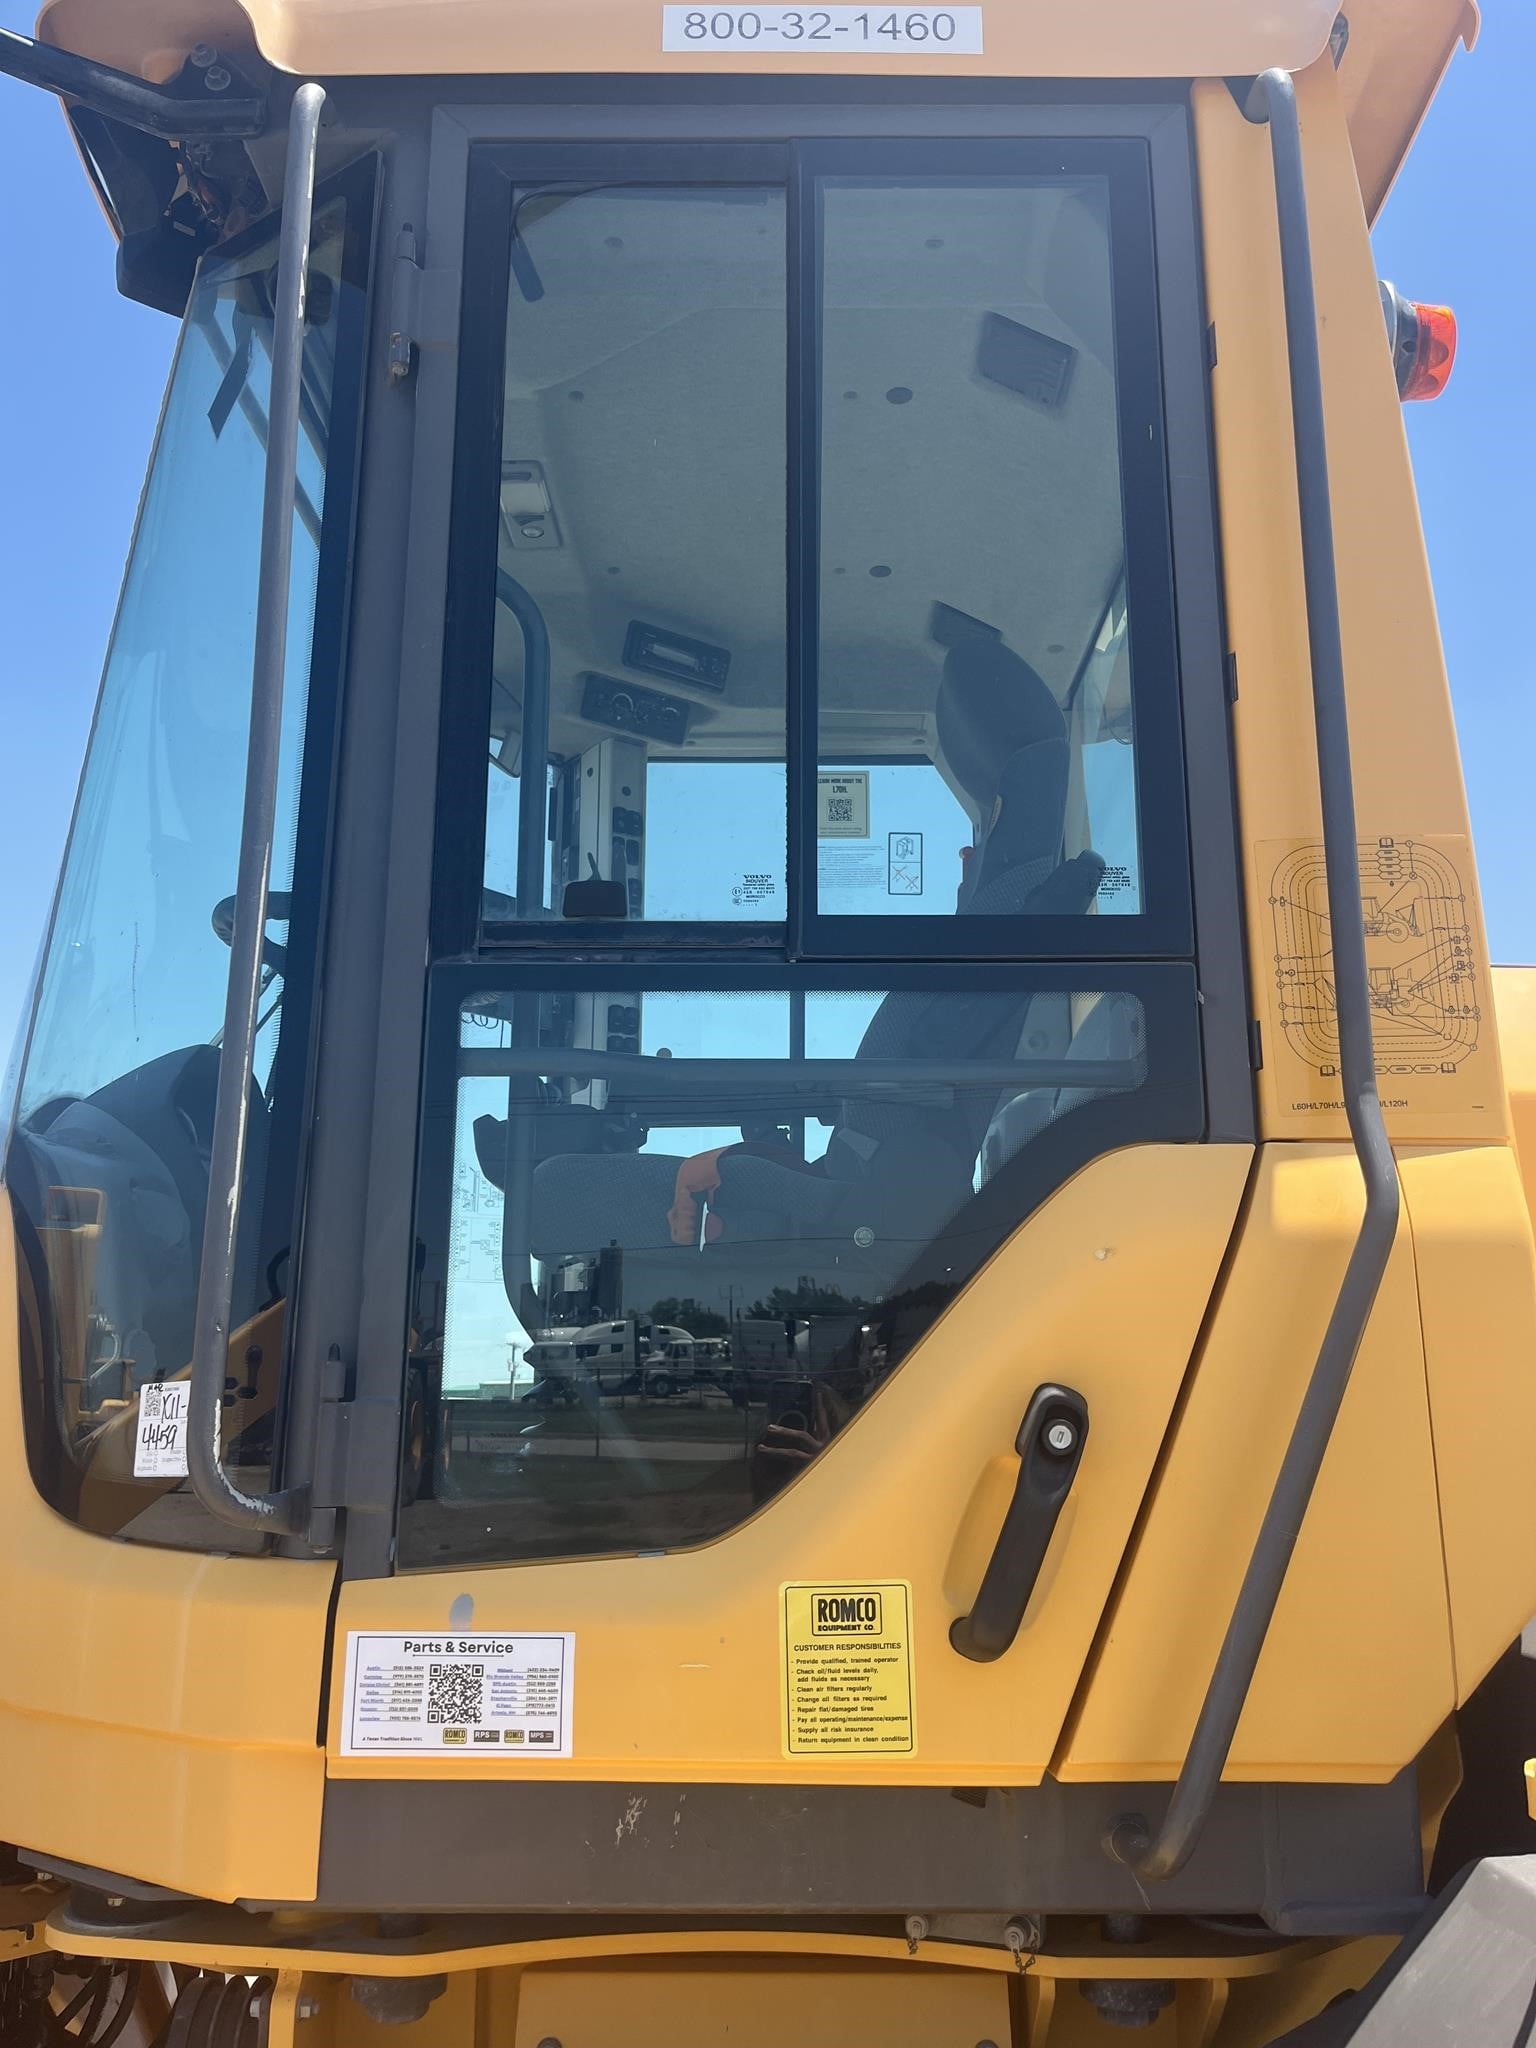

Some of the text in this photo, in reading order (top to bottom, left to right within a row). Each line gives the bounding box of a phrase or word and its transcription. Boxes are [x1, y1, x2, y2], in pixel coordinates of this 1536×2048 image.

[683, 12, 956, 41] 800-32-1460
[142, 1424, 177, 1450] 4459
[818, 1598, 876, 1622] ROMCO
[404, 1641, 513, 1653] Parts & Service
[794, 1643, 901, 1651] CUSTOMER RESPONSIBILITIES
